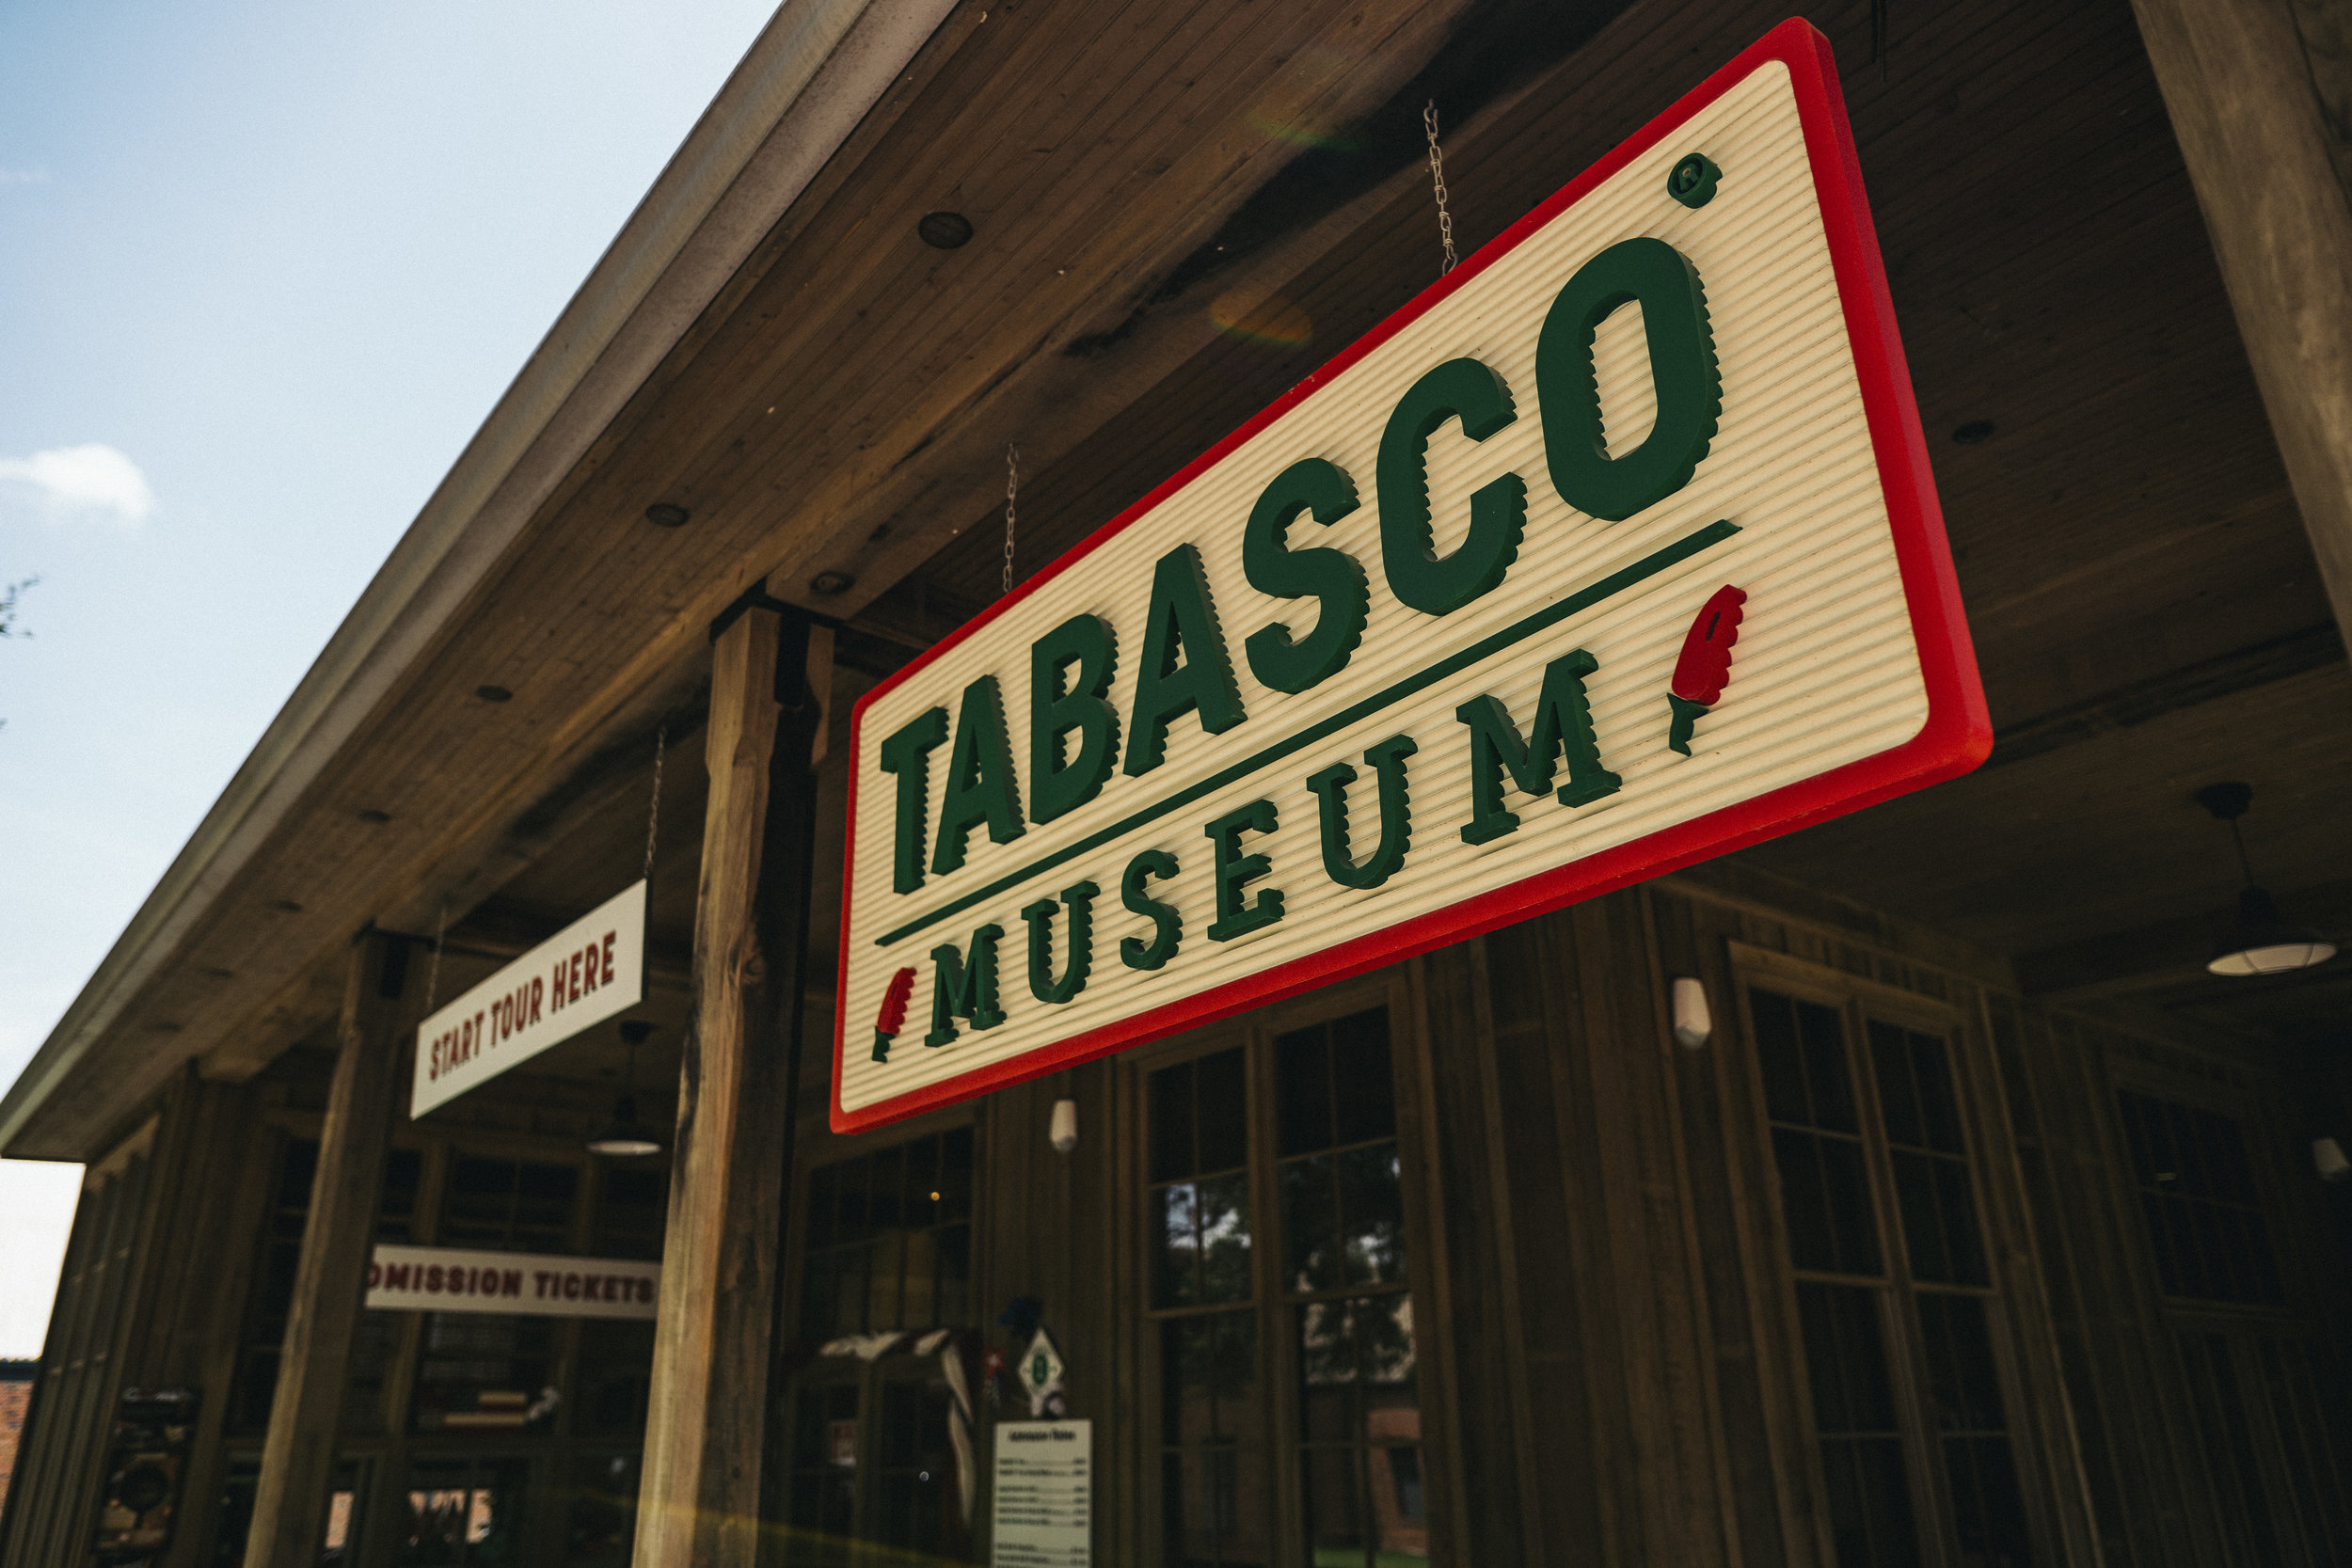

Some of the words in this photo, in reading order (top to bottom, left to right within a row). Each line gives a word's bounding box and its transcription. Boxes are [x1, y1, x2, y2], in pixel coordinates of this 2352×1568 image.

[881, 236, 1724, 895] TABASCO
[925, 649, 1622, 1047] MUSEUM
[429, 1010, 485, 1082] START
[491, 974, 544, 1048] TOUR
[551, 929, 617, 1014] HERE
[532, 1272, 656, 1304] TICKETS
